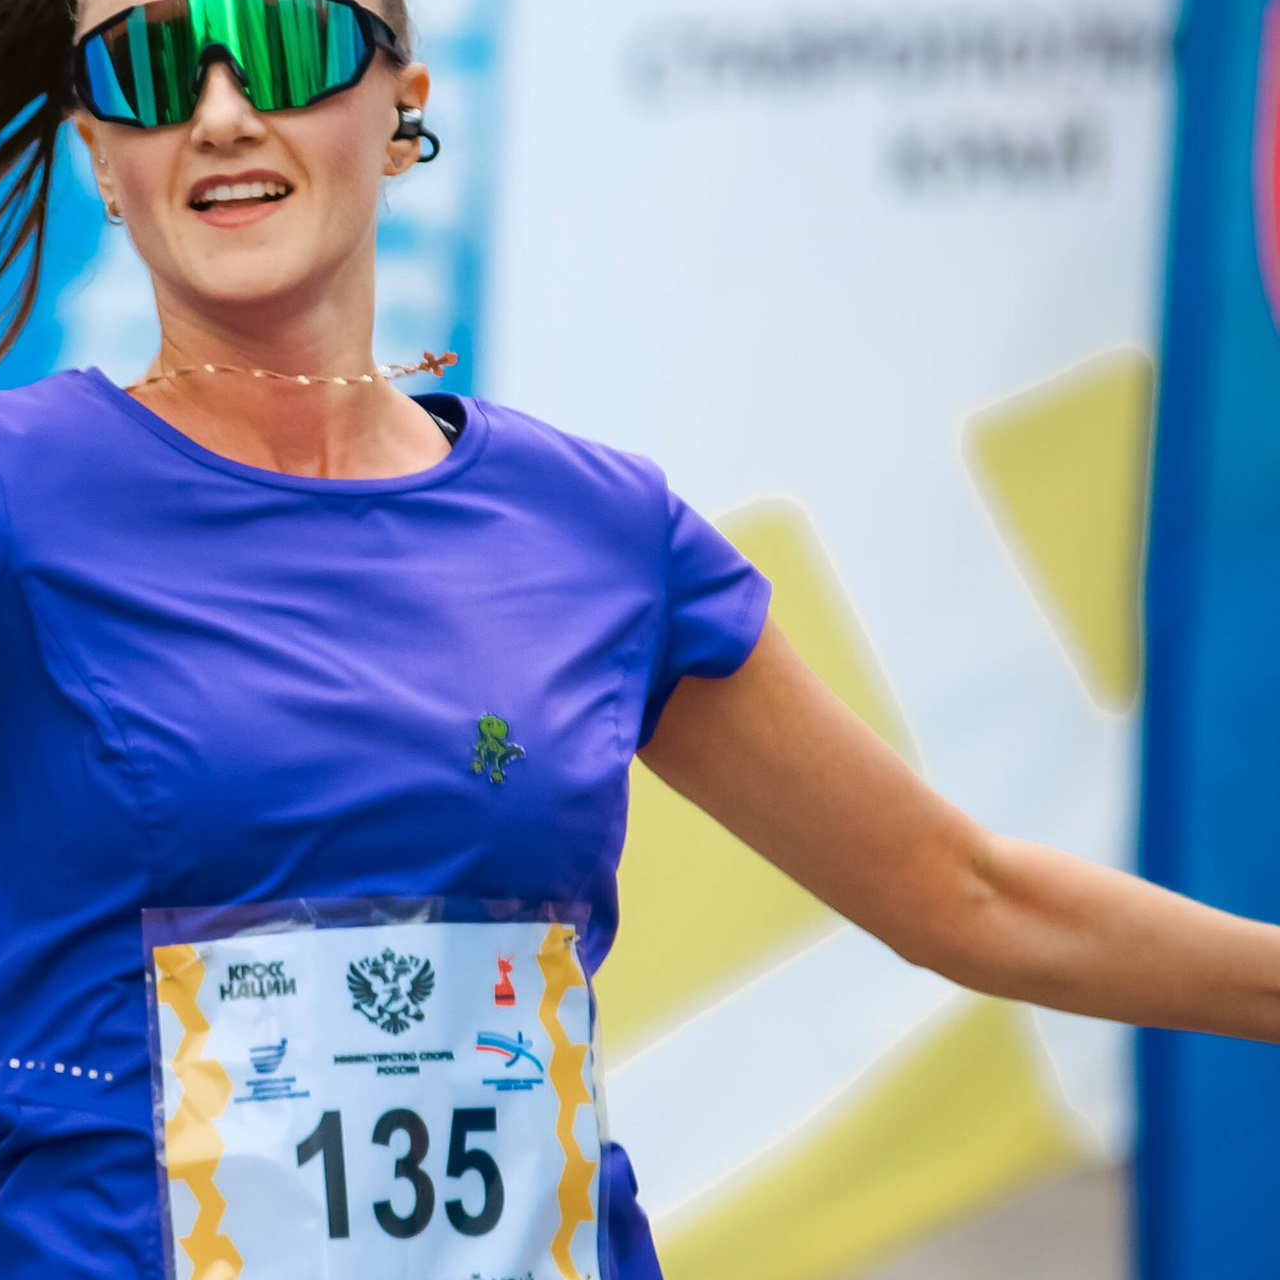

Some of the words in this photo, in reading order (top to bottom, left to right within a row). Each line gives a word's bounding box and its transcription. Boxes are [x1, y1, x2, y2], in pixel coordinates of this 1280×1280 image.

[228, 960, 286, 981] КРОСС
[219, 977, 297, 1001] НАЦИИ
[296, 1106, 505, 1240] 135
